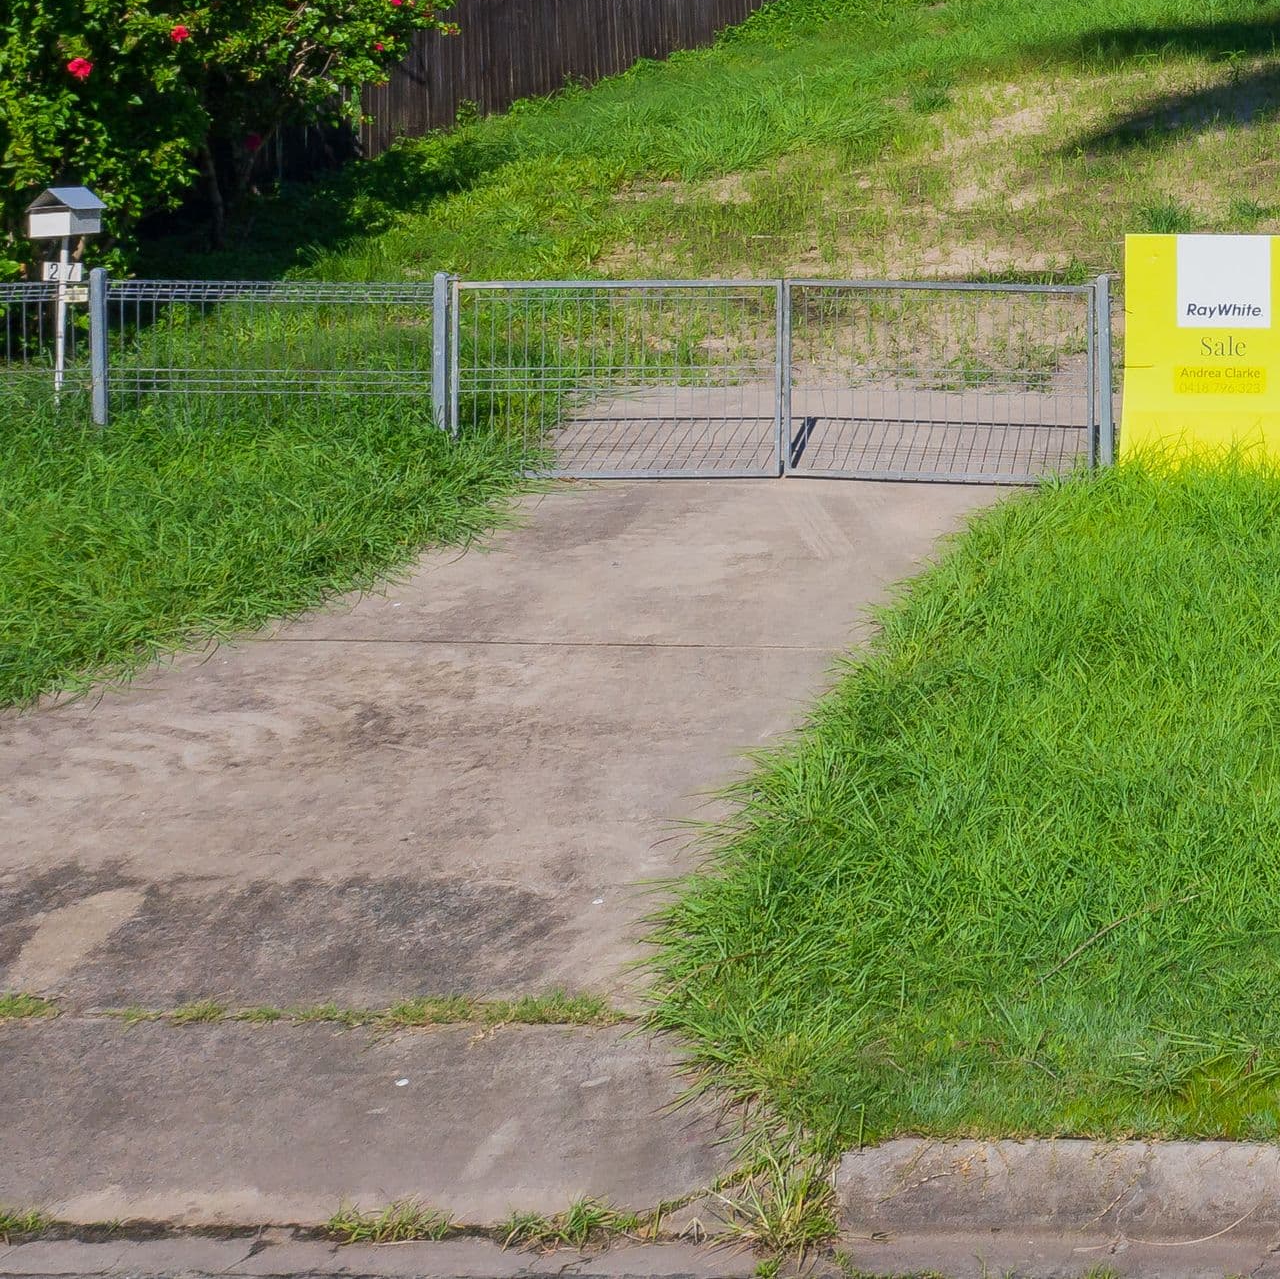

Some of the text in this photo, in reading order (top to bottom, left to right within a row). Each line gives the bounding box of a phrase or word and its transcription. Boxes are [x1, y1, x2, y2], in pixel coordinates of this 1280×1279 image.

[49, 263, 75, 280] 27
[1200, 336, 1246, 357] Sale
[1180, 367, 1261, 378] Andrea Clarke
